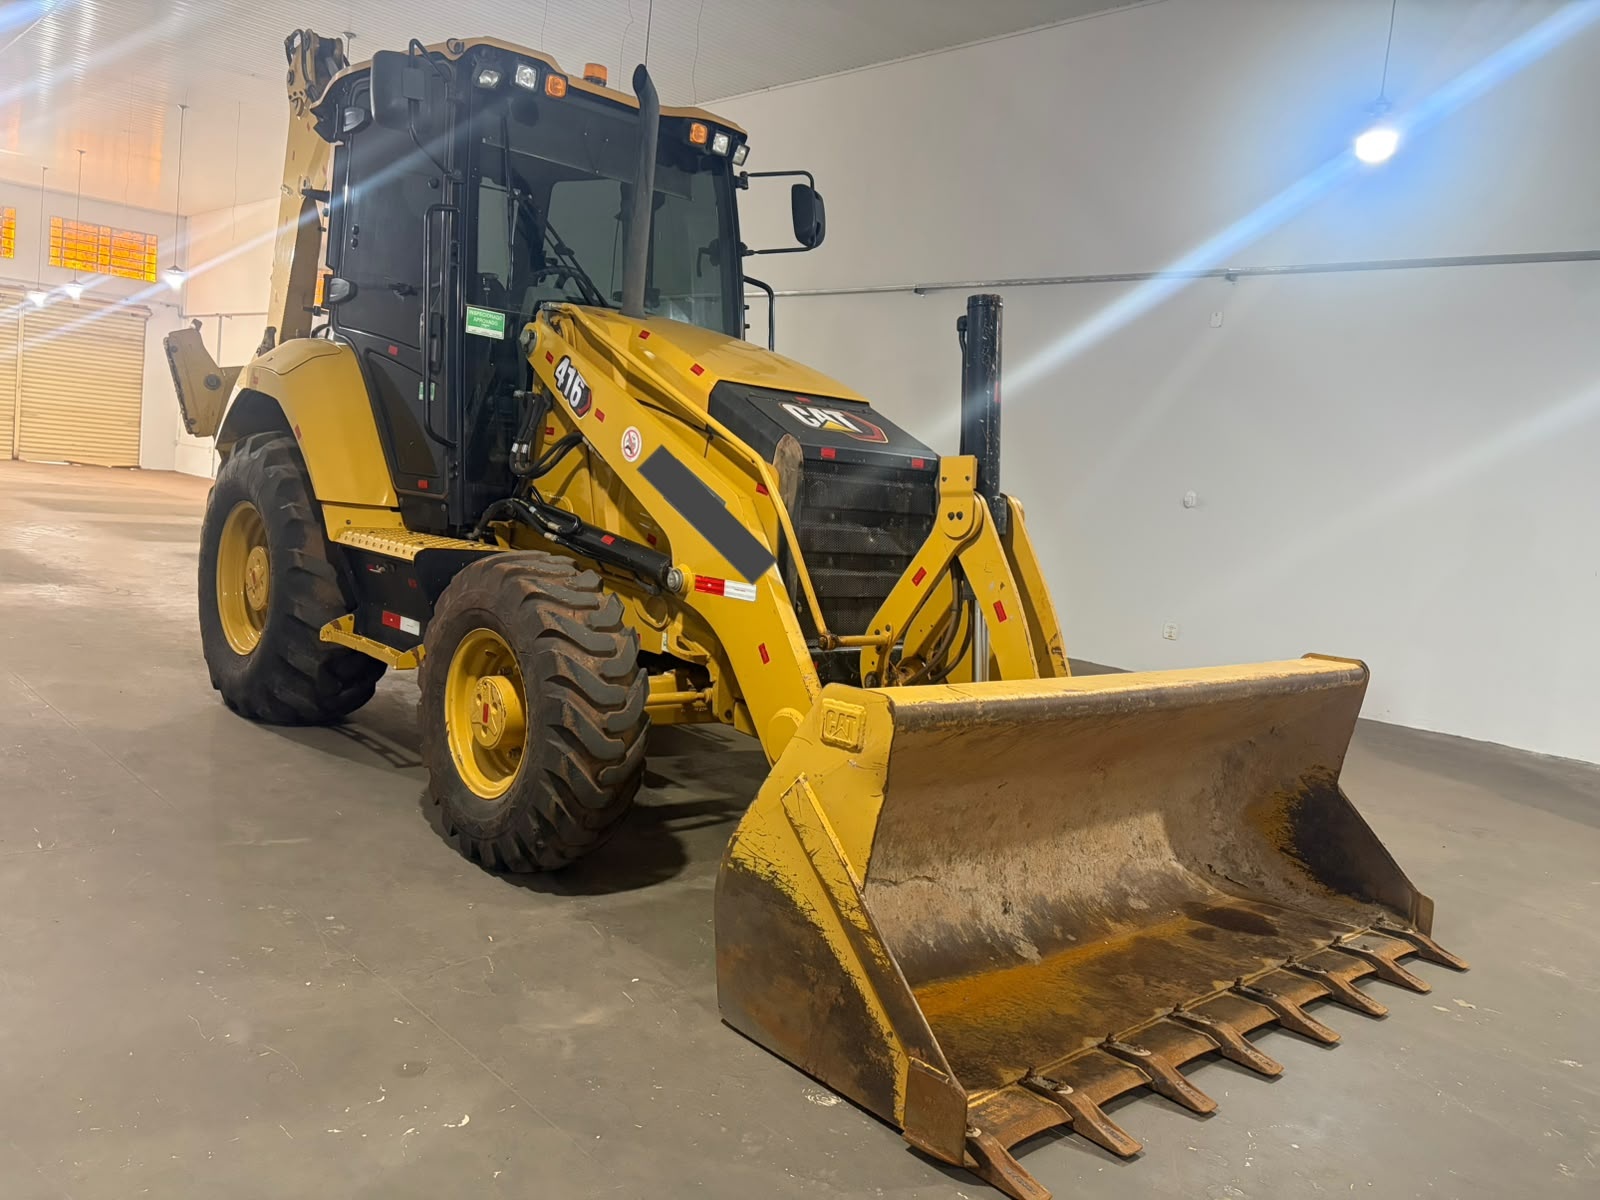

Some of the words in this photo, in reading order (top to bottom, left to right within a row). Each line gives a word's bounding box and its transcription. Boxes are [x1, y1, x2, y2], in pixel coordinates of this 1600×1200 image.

[555, 357, 585, 407] 416
[782, 403, 863, 433] CAT
[826, 709, 857, 741] CAT
